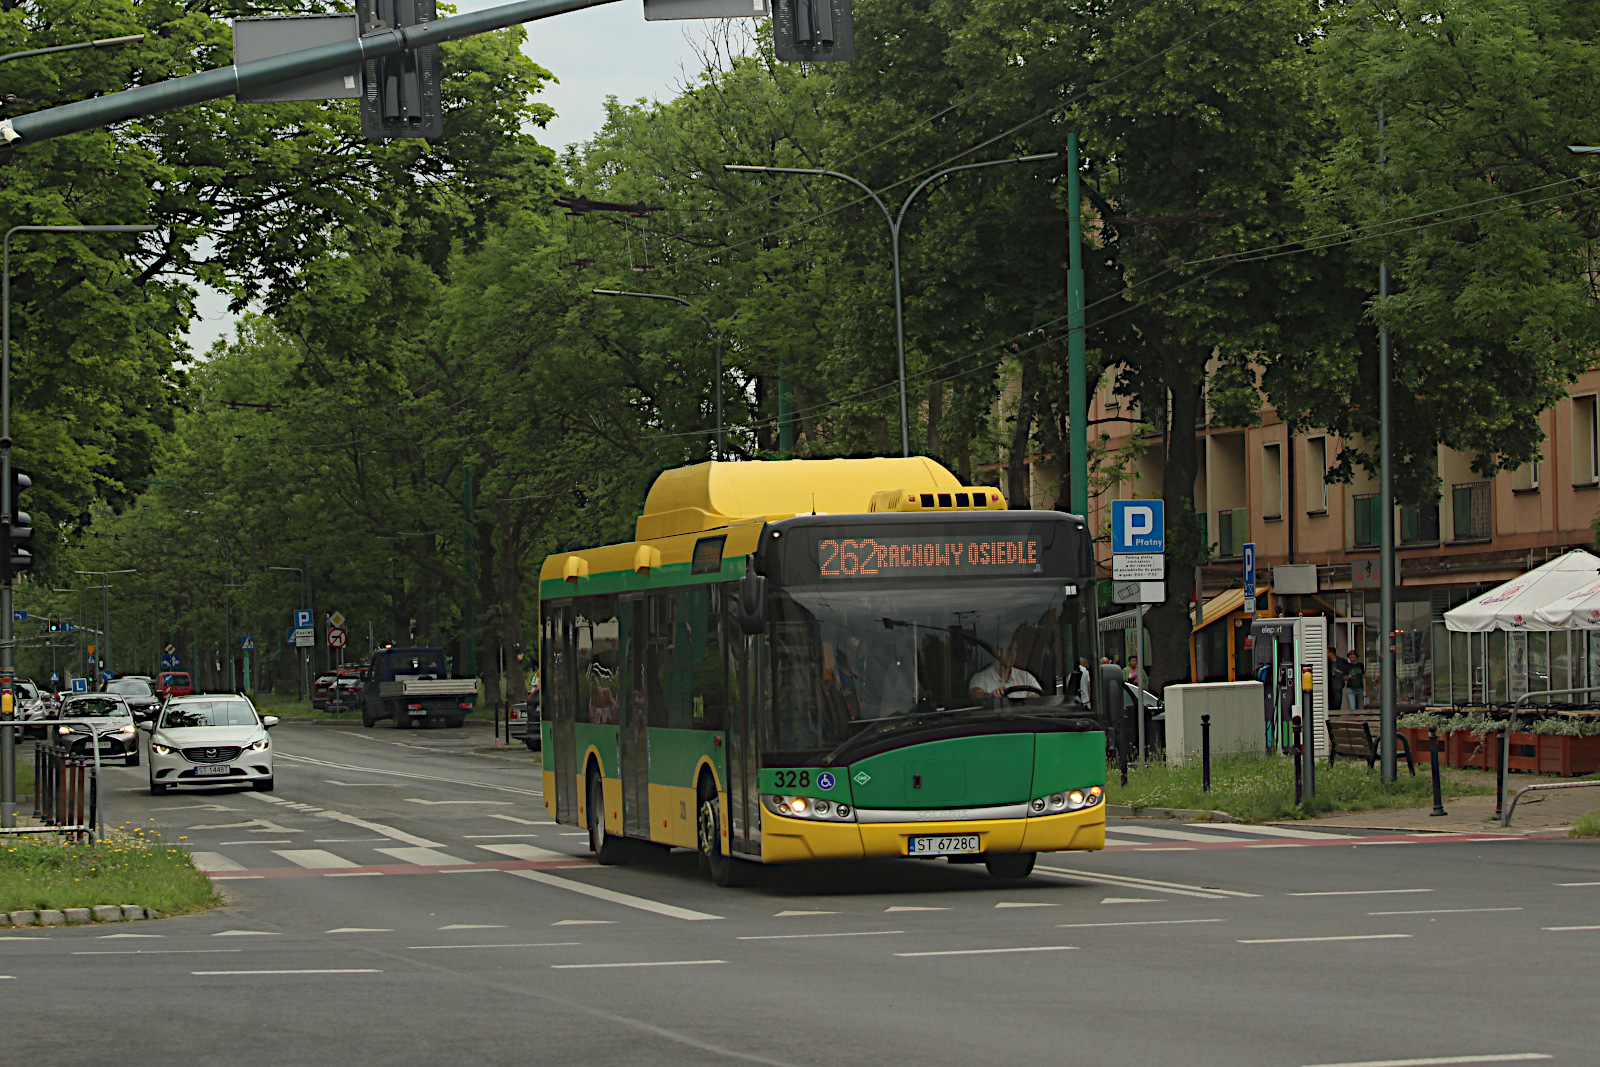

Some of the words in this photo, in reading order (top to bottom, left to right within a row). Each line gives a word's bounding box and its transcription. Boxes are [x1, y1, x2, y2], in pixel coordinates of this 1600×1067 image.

[1124, 506, 1153, 546] P
[1136, 538, 1162, 547] Płatny
[820, 538, 879, 576] 262
[877, 542, 964, 567] RACHOWY
[968, 541, 1037, 565] OSIEDLE
[298, 611, 310, 627] P
[76, 681, 84, 691] L
[774, 770, 811, 788] 328
[917, 809, 969, 820] SOLARIS
[917, 839, 934, 851] ST
[938, 837, 976, 850] 6728C
